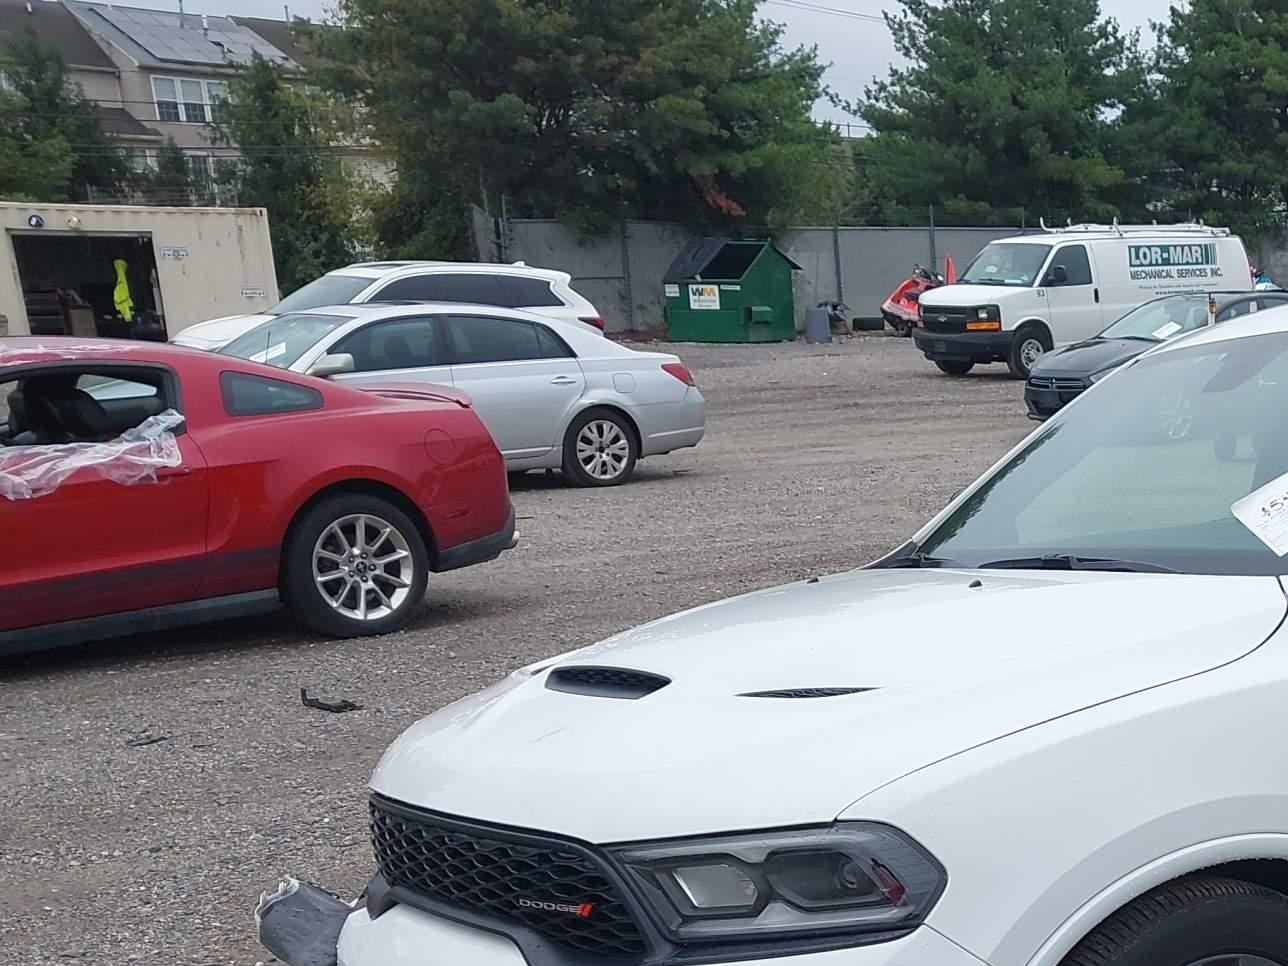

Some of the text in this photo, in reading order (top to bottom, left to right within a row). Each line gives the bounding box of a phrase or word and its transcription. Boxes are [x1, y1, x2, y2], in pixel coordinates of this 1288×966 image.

[1130, 245, 1202, 265] LOR-MAR
[1129, 266, 1223, 280] MECHANICAL SERVICES INC.
[690, 287, 716, 297] WM
[518, 898, 583, 914] DODGE
